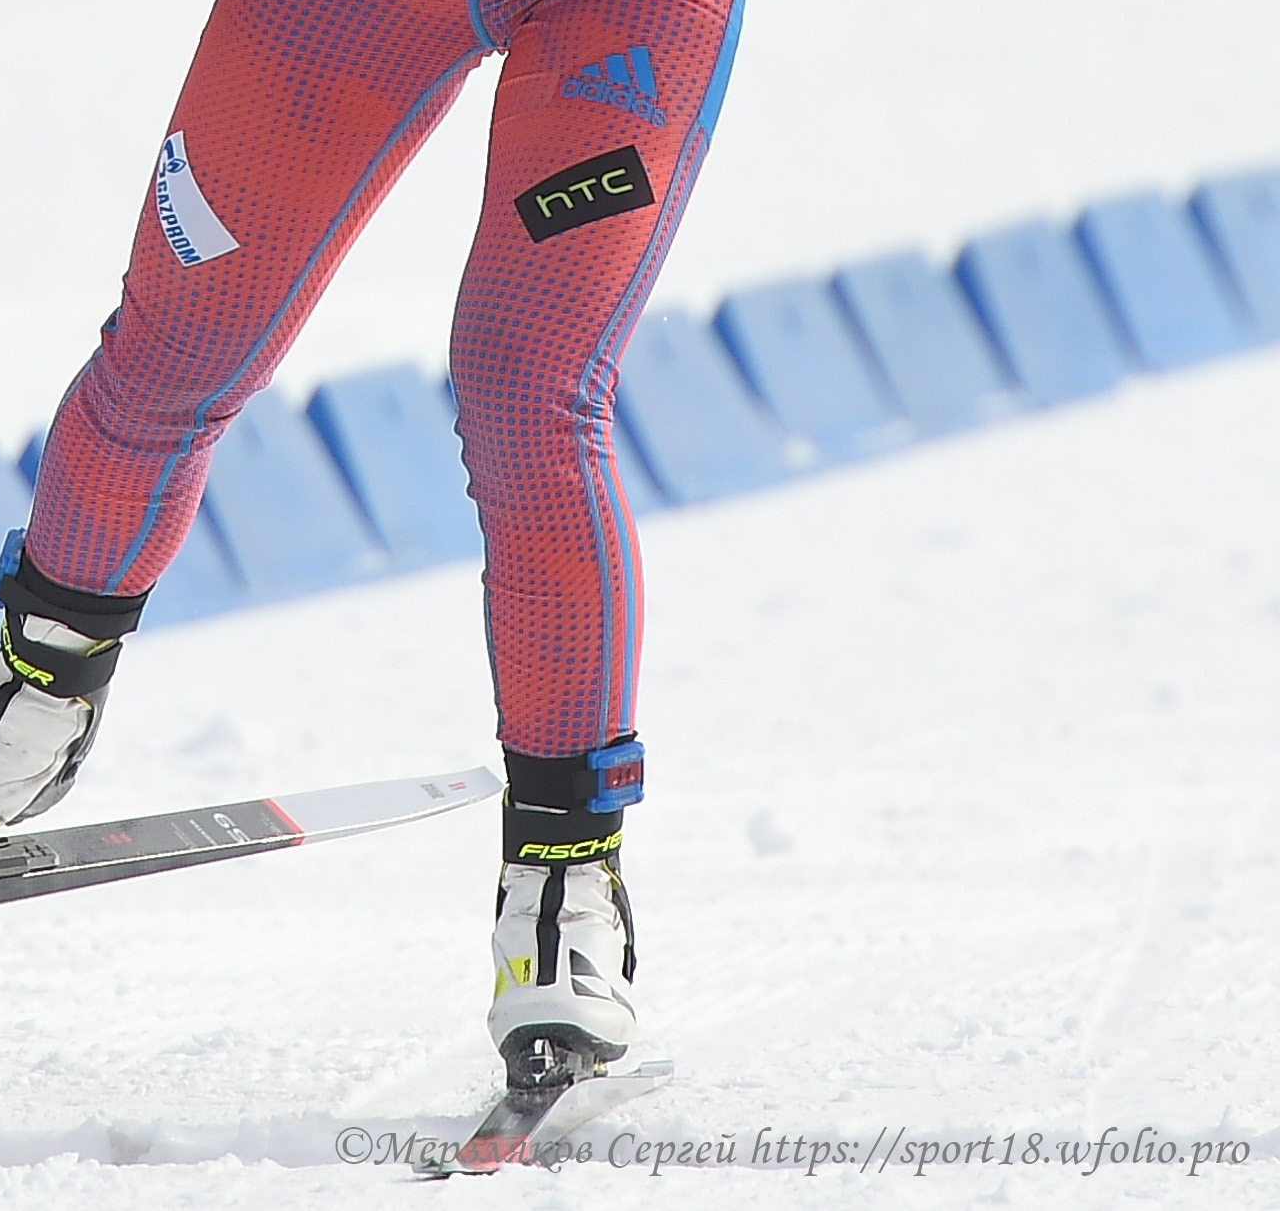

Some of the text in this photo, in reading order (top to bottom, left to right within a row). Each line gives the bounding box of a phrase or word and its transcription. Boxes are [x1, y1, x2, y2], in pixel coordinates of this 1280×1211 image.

[561, 77, 667, 129] adidas
[157, 179, 202, 265] GAZPROM
[1, 618, 55, 687] CHER
[518, 828, 623, 860] FISCHE
